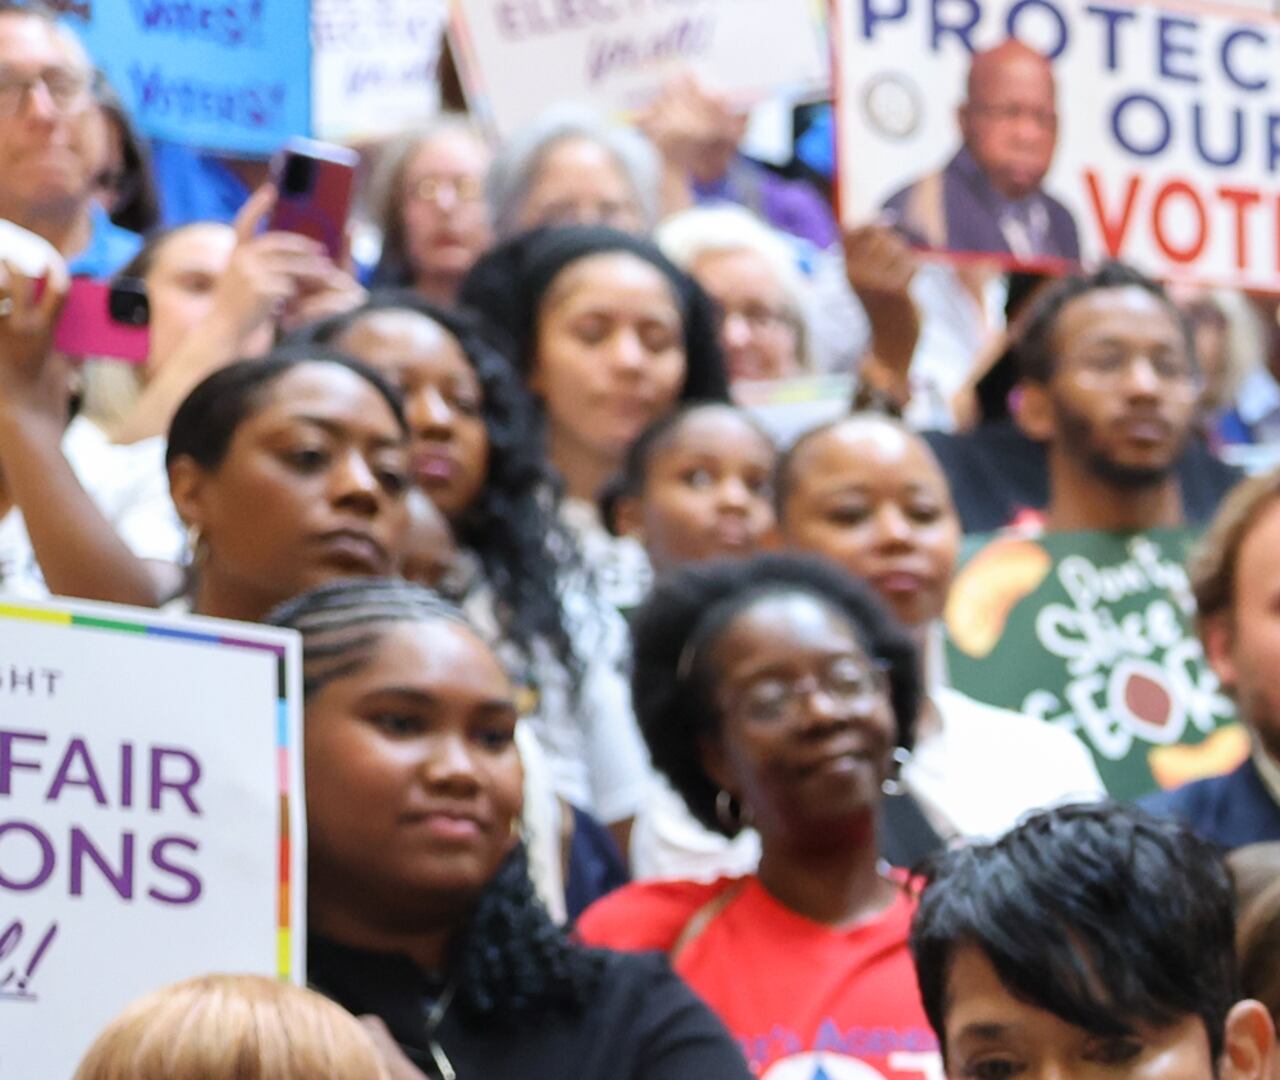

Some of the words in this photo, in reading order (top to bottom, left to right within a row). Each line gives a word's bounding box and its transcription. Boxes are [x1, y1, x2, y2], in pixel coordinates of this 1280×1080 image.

[0, 667, 62, 696] HT
[0, 729, 203, 815] FAIR
[0, 821, 202, 906] ONS
